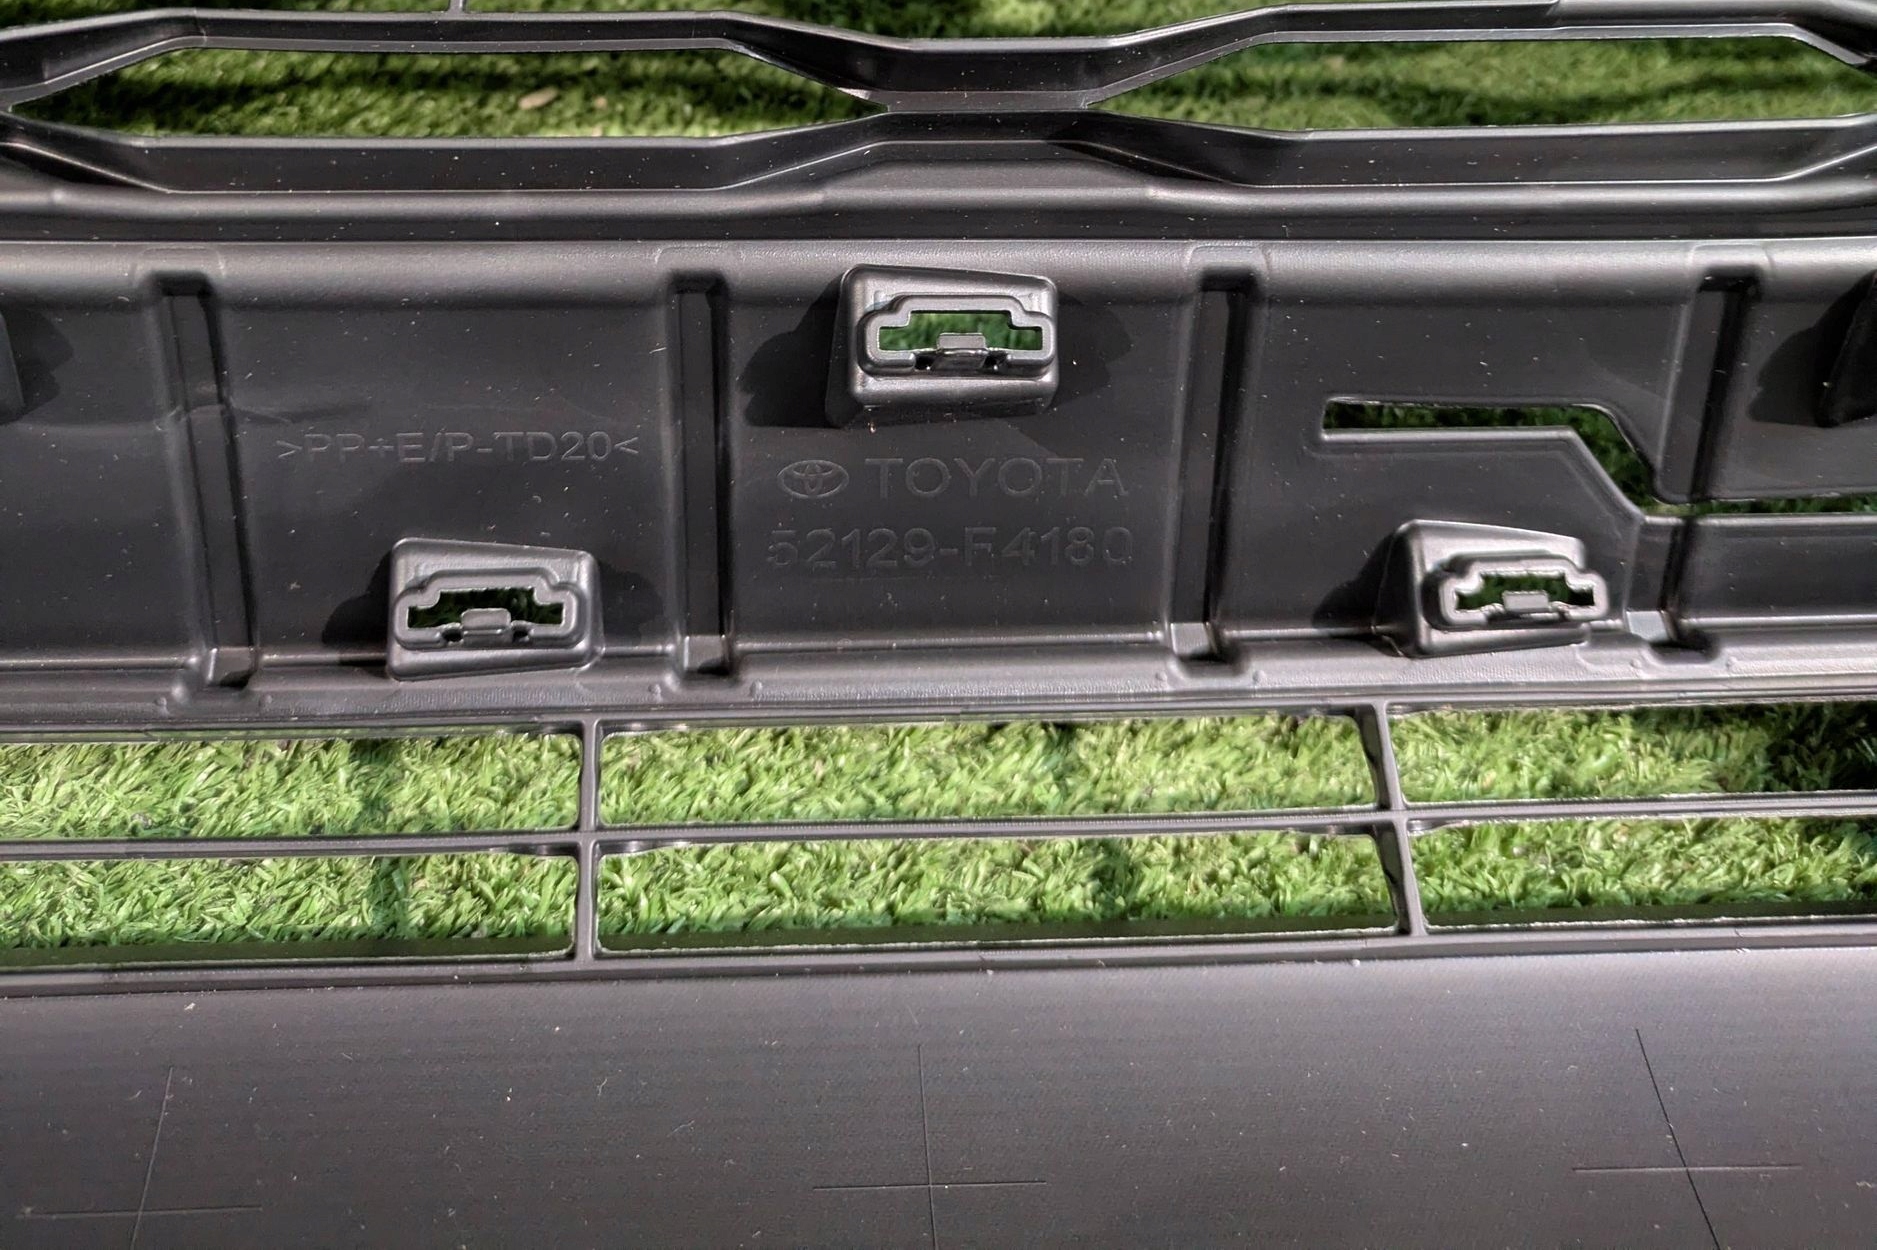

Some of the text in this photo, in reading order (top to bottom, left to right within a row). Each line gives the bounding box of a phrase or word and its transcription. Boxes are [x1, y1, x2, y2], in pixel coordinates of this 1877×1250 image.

[276, 430, 639, 462] >PP+E/P-TD20<
[865, 457, 1129, 498] TOYOTA
[766, 526, 1135, 568] 52129-F4180
